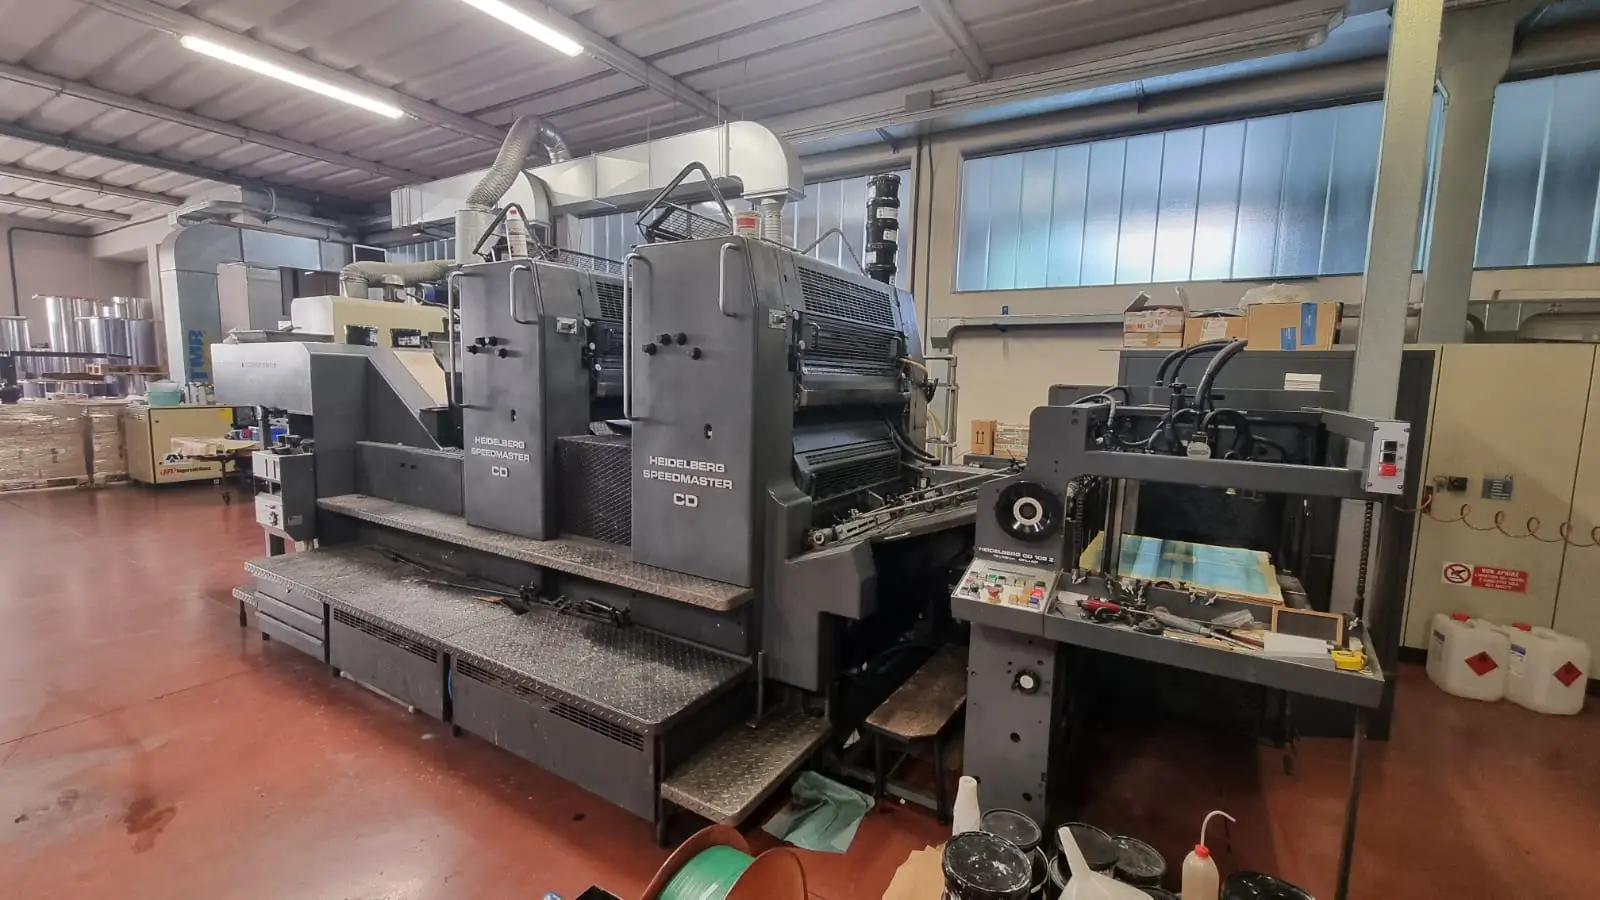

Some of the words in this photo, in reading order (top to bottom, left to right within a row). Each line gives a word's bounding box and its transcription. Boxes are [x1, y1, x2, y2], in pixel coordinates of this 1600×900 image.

[474, 436, 525, 449] HEIDELBERG
[470, 447, 531, 463] SPEEDMASTER
[491, 465, 508, 478] CD
[649, 455, 725, 473] HEIDELBERG
[642, 469, 733, 489] SPEEDMASTER
[673, 492, 699, 508] CD
[978, 546, 1021, 557] HEIDELBERG
